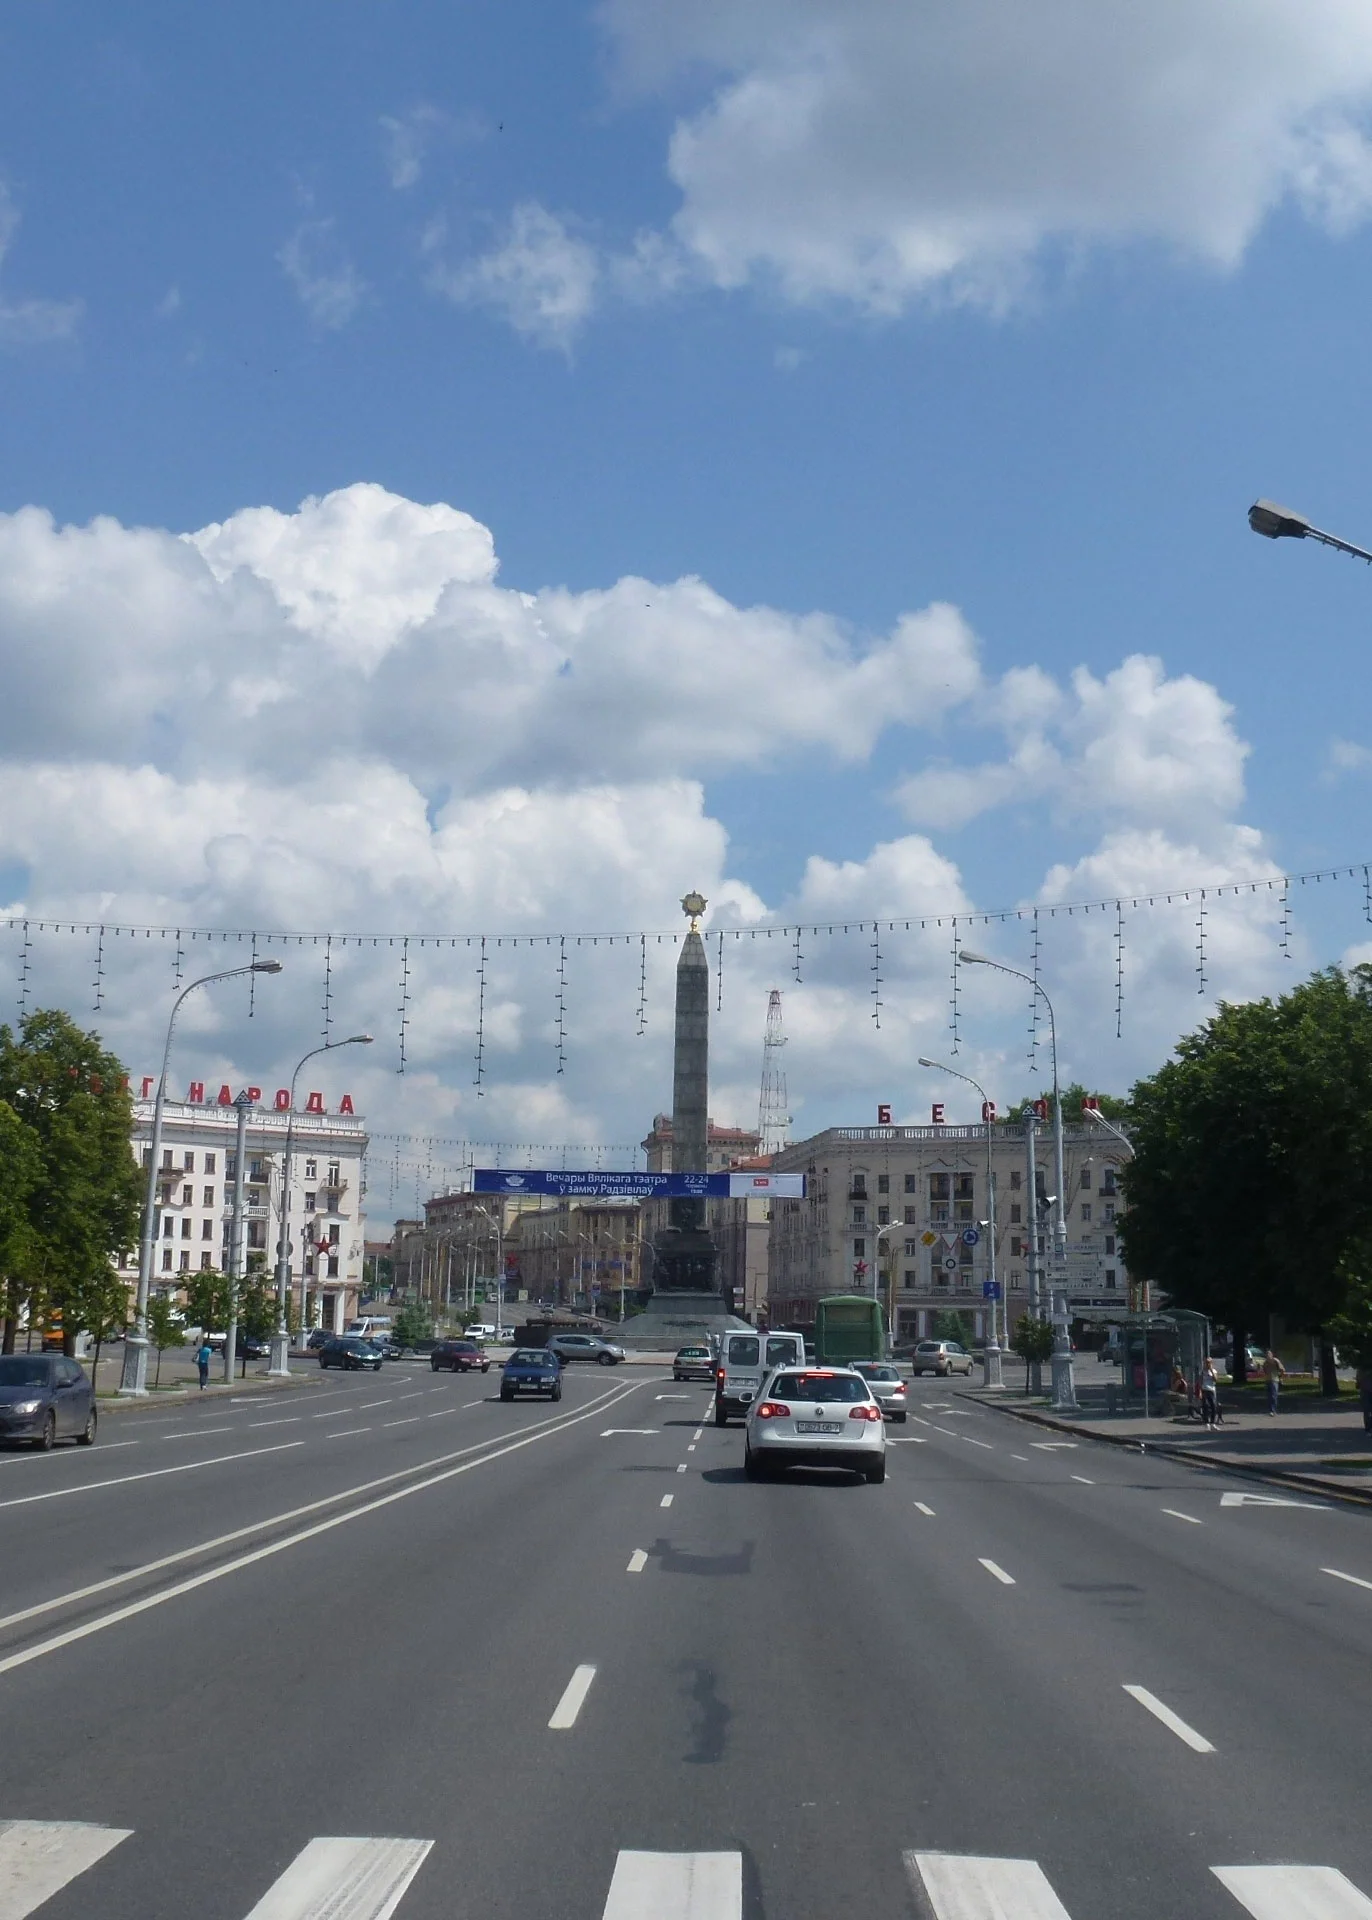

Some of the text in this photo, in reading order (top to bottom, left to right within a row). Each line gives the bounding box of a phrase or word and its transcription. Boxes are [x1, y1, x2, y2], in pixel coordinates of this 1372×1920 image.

[190, 1081, 354, 1115] НАРОДА
[546, 1173, 667, 1186] Вечары Вялікага тэатра
[684, 1174, 709, 1183] 22-24
[559, 1183, 653, 1196] ў замку Радзівілаў
